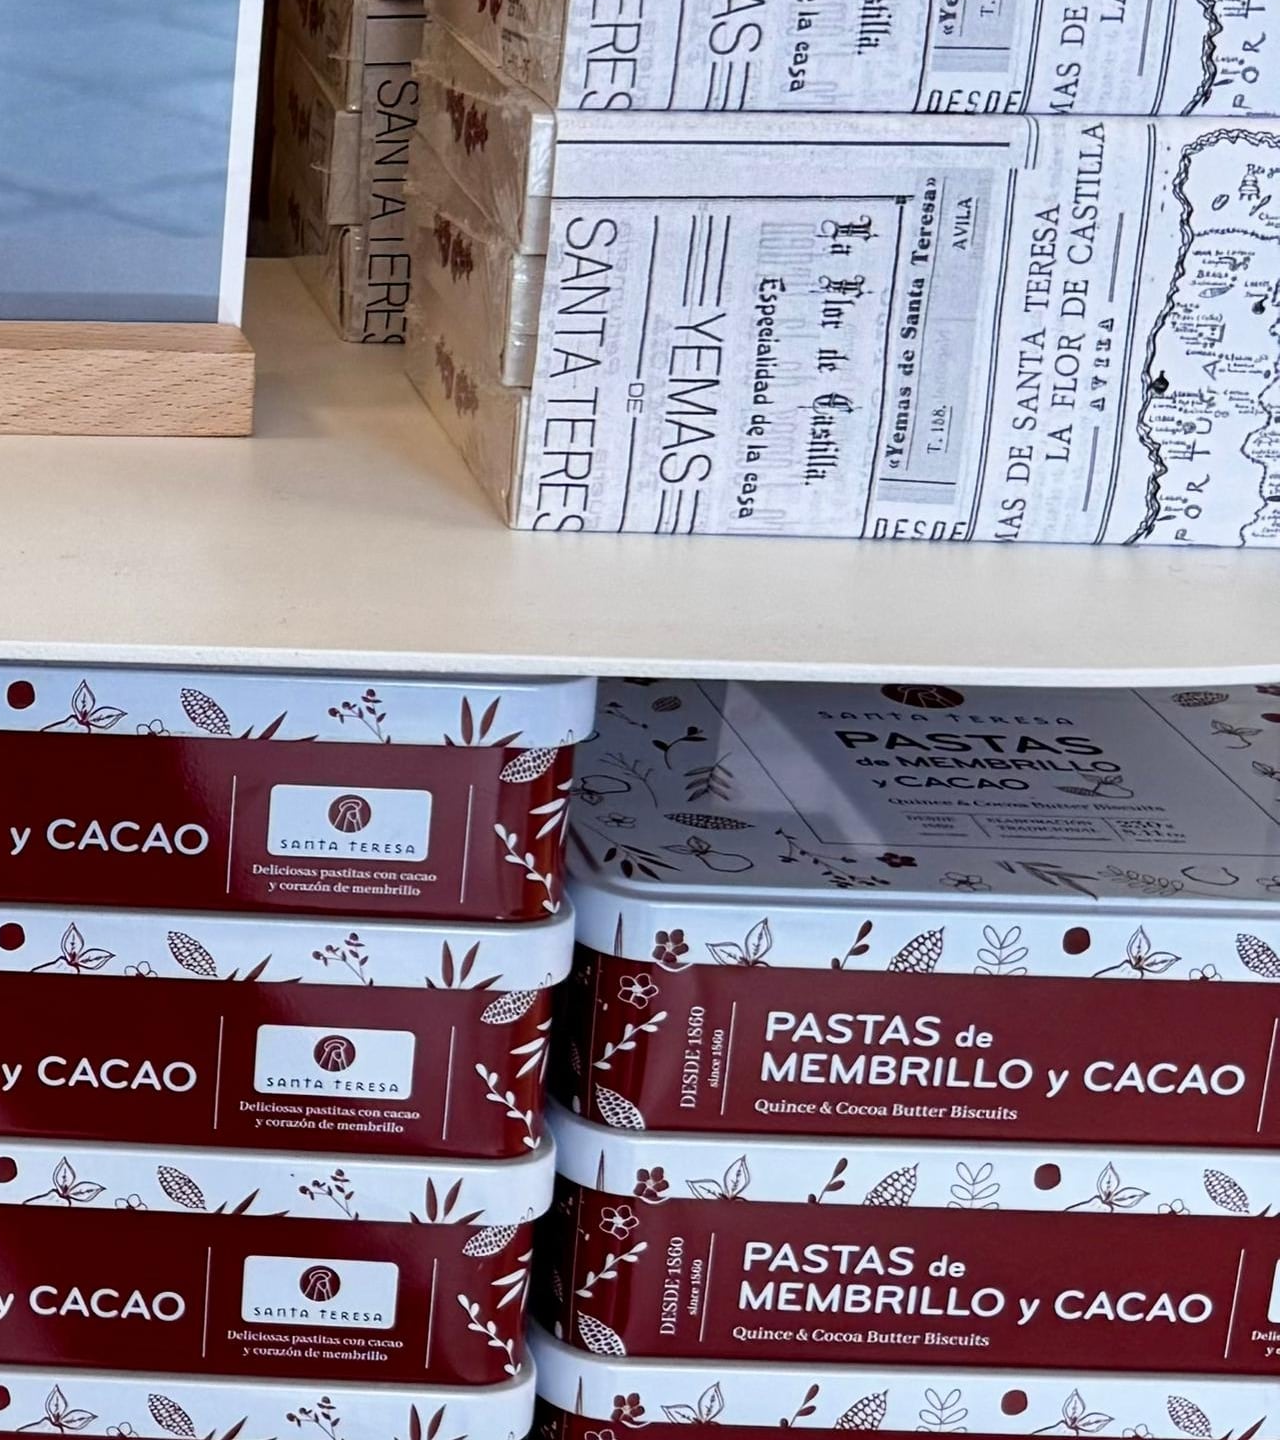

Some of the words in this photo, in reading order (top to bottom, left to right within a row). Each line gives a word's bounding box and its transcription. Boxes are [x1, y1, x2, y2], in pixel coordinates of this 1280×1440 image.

[797, 10, 820, 32] la
[1061, 5, 1089, 49] DE
[789, 41, 810, 93] casa
[549, 216, 618, 379] SANTA
[658, 312, 727, 484] YEMAS
[817, 711, 929, 722] SANTA
[945, 713, 1074, 726] TERESA
[834, 730, 1104, 756] PASTAS
[855, 756, 890, 767] de
[895, 755, 1121, 773] MEMBRILLO
[894, 775, 1030, 791] CACAO
[10, 827, 31, 856] y
[46, 818, 209, 855] CACAO
[280, 839, 338, 851] SANTA
[349, 840, 415, 854] TERESA
[252, 863, 318, 877] Deliciosas
[319, 868, 372, 880] pastitas
[373, 871, 397, 881] con
[399, 873, 437, 882] cacao
[267, 881, 277, 893] y
[279, 880, 331, 892] corazón
[332, 882, 351, 893] de
[352, 883, 421, 896] membrillo
[765, 1011, 941, 1047] PASTAS
[955, 1024, 994, 1048] de
[760, 1051, 1033, 1090] MEMBRILLO
[1046, 1069, 1070, 1098] y
[1083, 1061, 1246, 1096] CACAO
